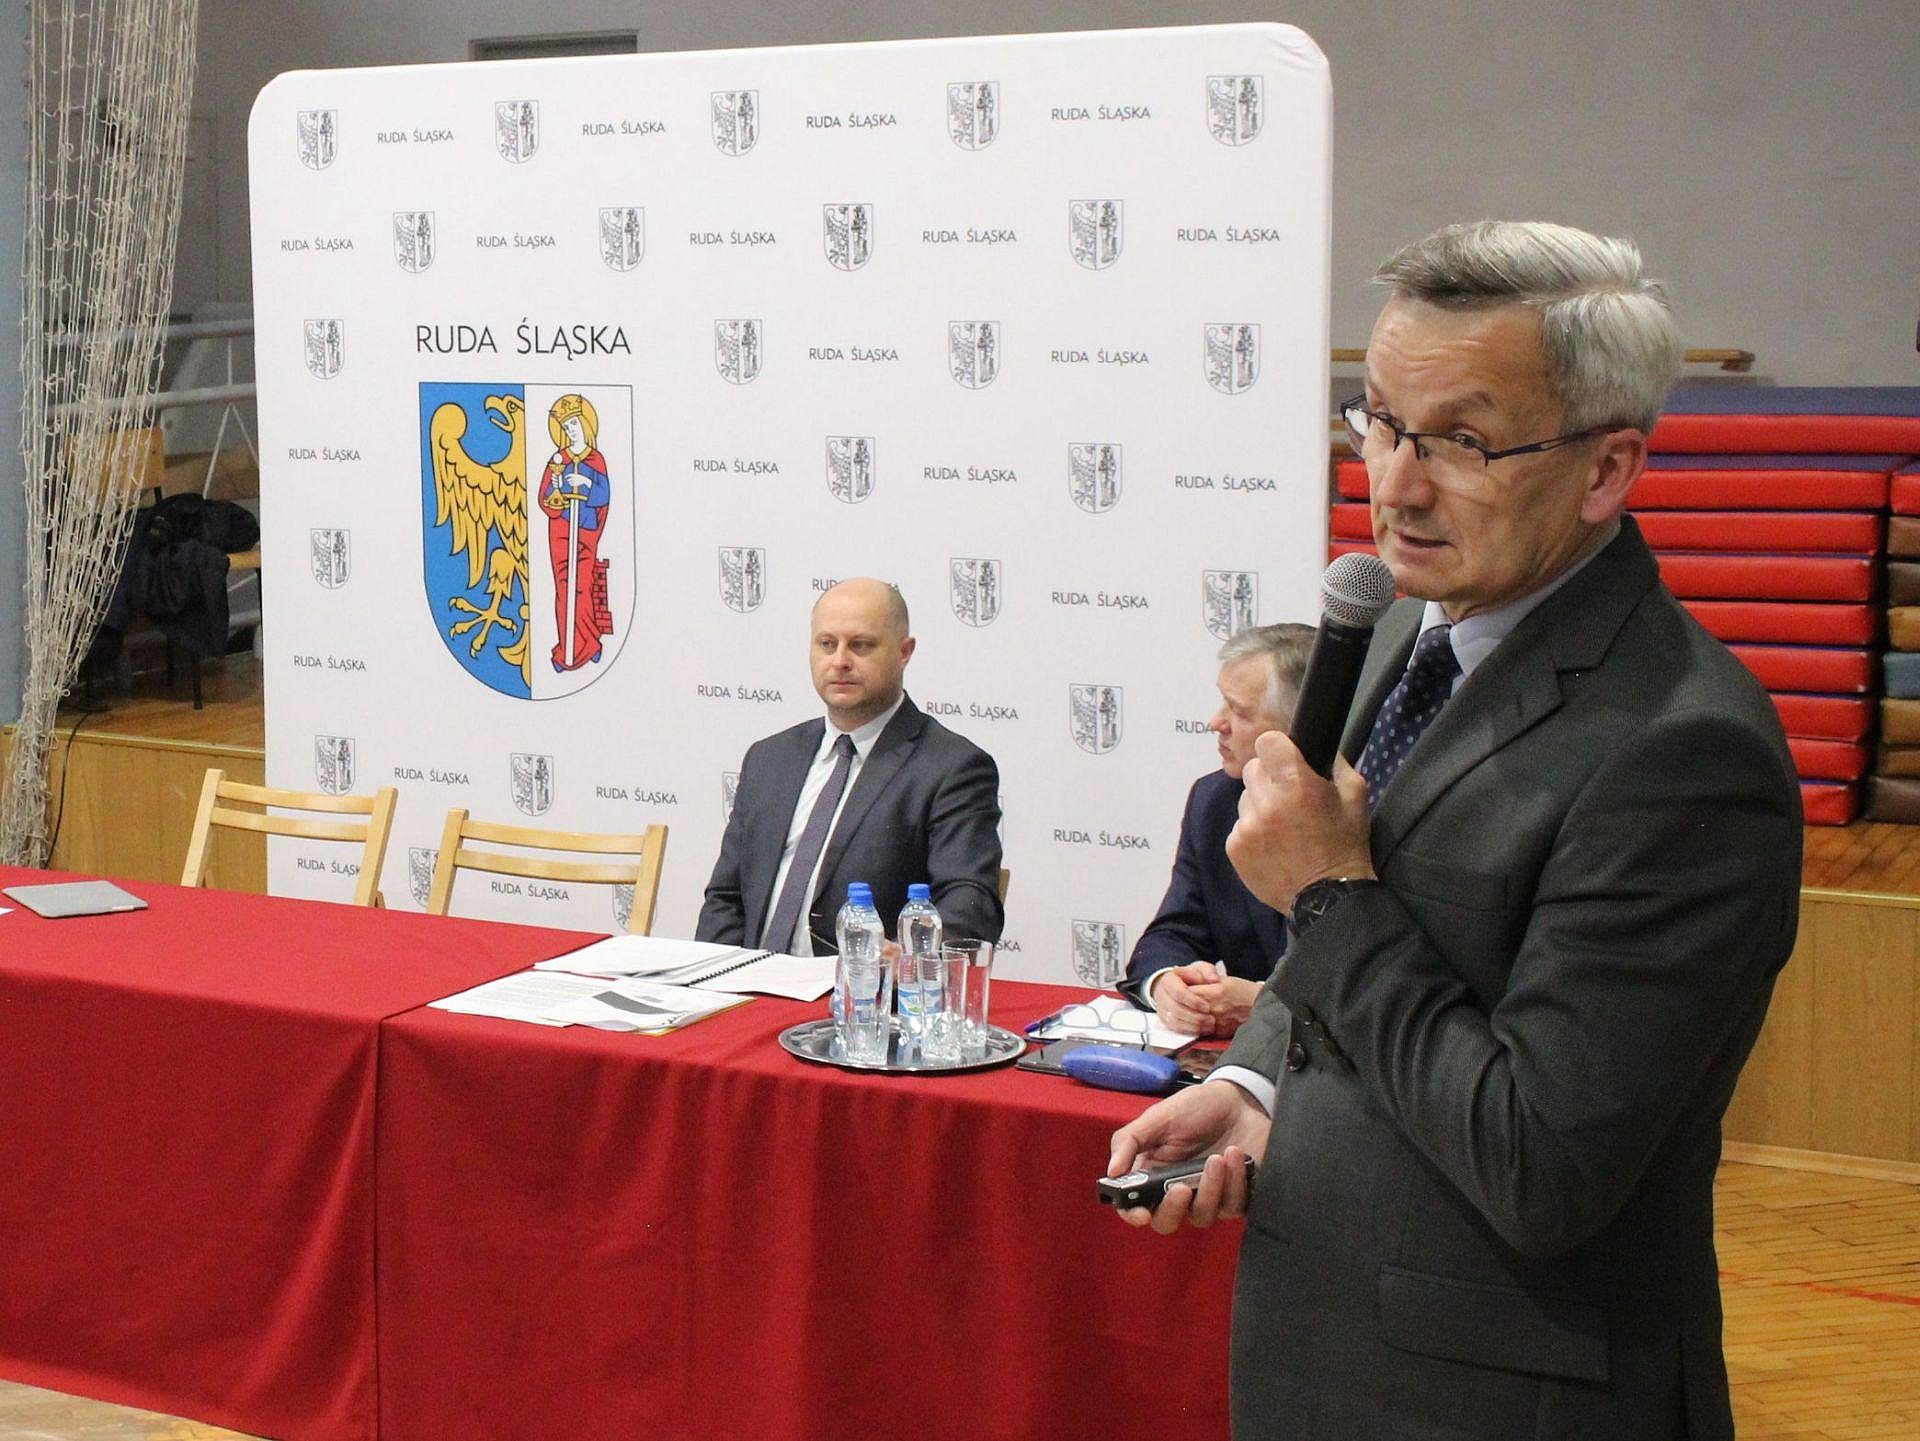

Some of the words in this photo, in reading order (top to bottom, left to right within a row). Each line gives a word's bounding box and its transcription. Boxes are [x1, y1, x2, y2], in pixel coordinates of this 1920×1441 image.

[806, 116, 841, 128] RUDA
[849, 113, 896, 129] ŚLĄSKA
[1052, 108, 1090, 120] RUDA
[1098, 105, 1151, 122] ŚLĄSKA
[378, 132, 407, 143] RUDA
[413, 130, 453, 144] ŚLĄSKA
[583, 124, 615, 135] RUDA
[621, 120, 665, 136] ŚLĄSKA
[477, 236, 507, 247] RUDA
[514, 233, 555, 249] ŚLĄSKA
[690, 233, 724, 245] RUDA
[731, 230, 775, 247] ŚLĄSKA
[923, 231, 959, 243] RUDA
[967, 228, 1016, 245] ŚLĄSKA
[1177, 229, 1217, 241] RUDA
[1226, 225, 1280, 244] ŚLĄSKA
[281, 240, 309, 251] RUDA
[315, 237, 353, 252] ŚLĄSKA
[417, 325, 498, 353] RUDA
[517, 317, 632, 361] ŚLĄSKA
[809, 348, 844, 360] RUDA
[852, 346, 899, 362] ŚLĄSKA
[1051, 351, 1089, 363] RUDA
[1098, 348, 1149, 366] ŚLĄSKA
[289, 448, 317, 459] RUDA
[323, 447, 361, 462] ŚLĄSKA
[694, 460, 727, 472] RUDA
[734, 457, 779, 476] ŚLĄSKA
[924, 467, 960, 480] RUDA
[968, 465, 1017, 484] ŚLĄSKA
[1175, 475, 1214, 489] RUDA
[1223, 473, 1276, 493] ŚLĄSKA
[812, 578, 841, 592] RUD
[1052, 592, 1090, 605] RUDA
[1098, 590, 1149, 610] ŚLĄSKA
[294, 656, 322, 667] RUDA
[328, 655, 366, 672] ŚLĄSKA
[698, 685, 731, 698] RUDA
[738, 684, 782, 703] ŚLĄSKA
[926, 702, 963, 715] RUDA
[970, 701, 1019, 721] ŚLĄSKA
[395, 767, 424, 780] RUDA
[430, 767, 469, 785] ŚLĄSKA
[596, 786, 628, 800] RUDA
[634, 786, 677, 805] ŚLĄSKA
[1054, 829, 1091, 843] RUDA
[1099, 829, 1150, 850] ŚLĄSKA
[298, 858, 325, 871] RUDA
[331, 860, 361, 877] ŚLĄSK
[491, 882, 524, 895] RUDA
[529, 882, 569, 902] ŚLĄSKA
